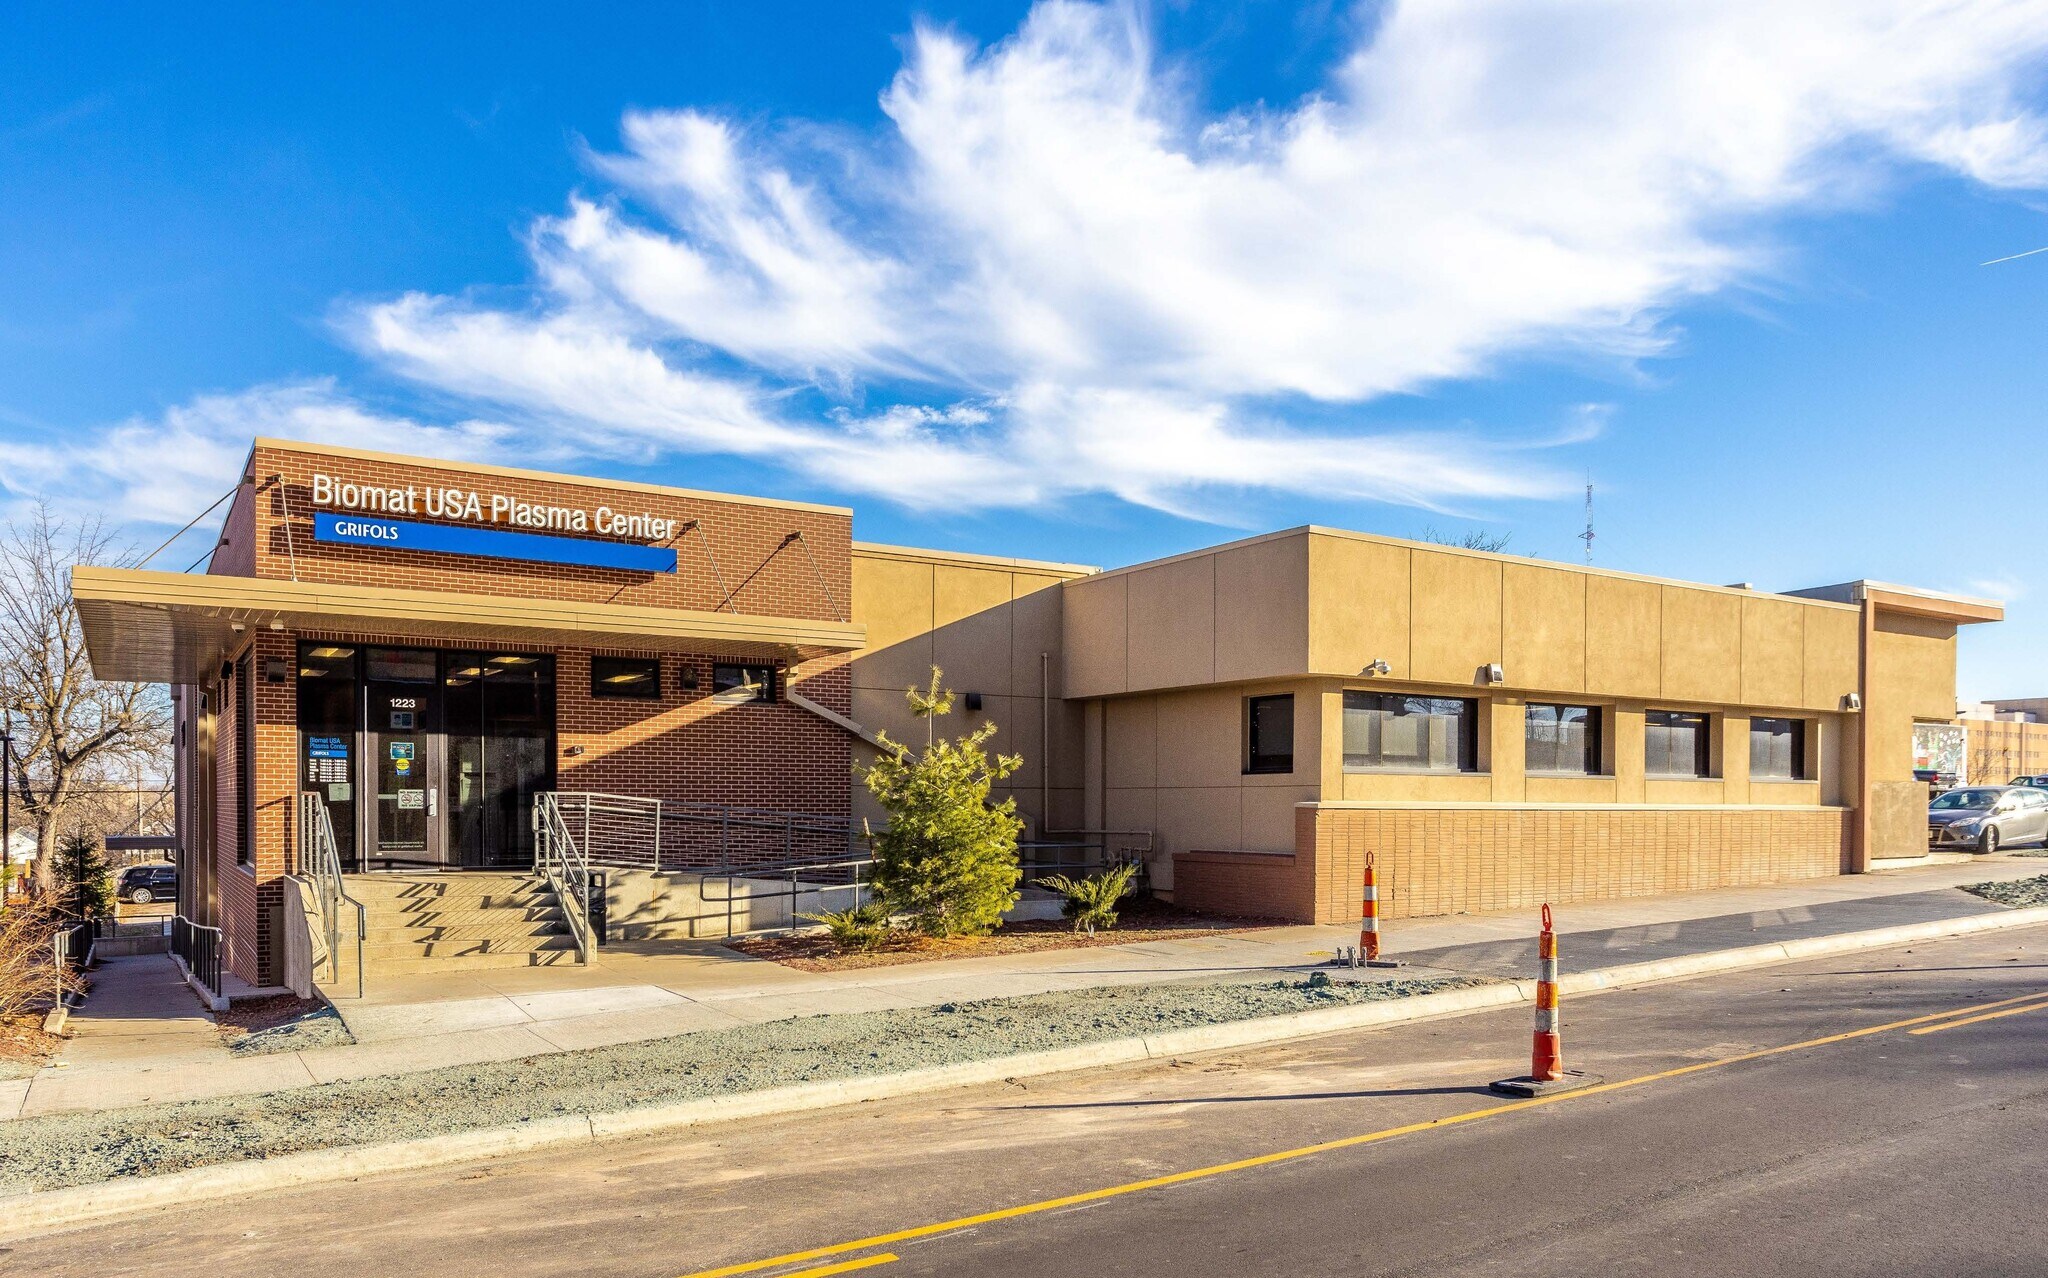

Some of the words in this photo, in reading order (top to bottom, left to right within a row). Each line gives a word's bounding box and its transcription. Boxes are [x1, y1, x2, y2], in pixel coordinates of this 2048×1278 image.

[313, 474, 417, 514] Biomat
[426, 487, 484, 521] USA
[491, 495, 587, 532] Plasma
[594, 506, 675, 540] Center
[334, 521, 399, 540] GRIFOLS
[390, 698, 416, 708] 1223
